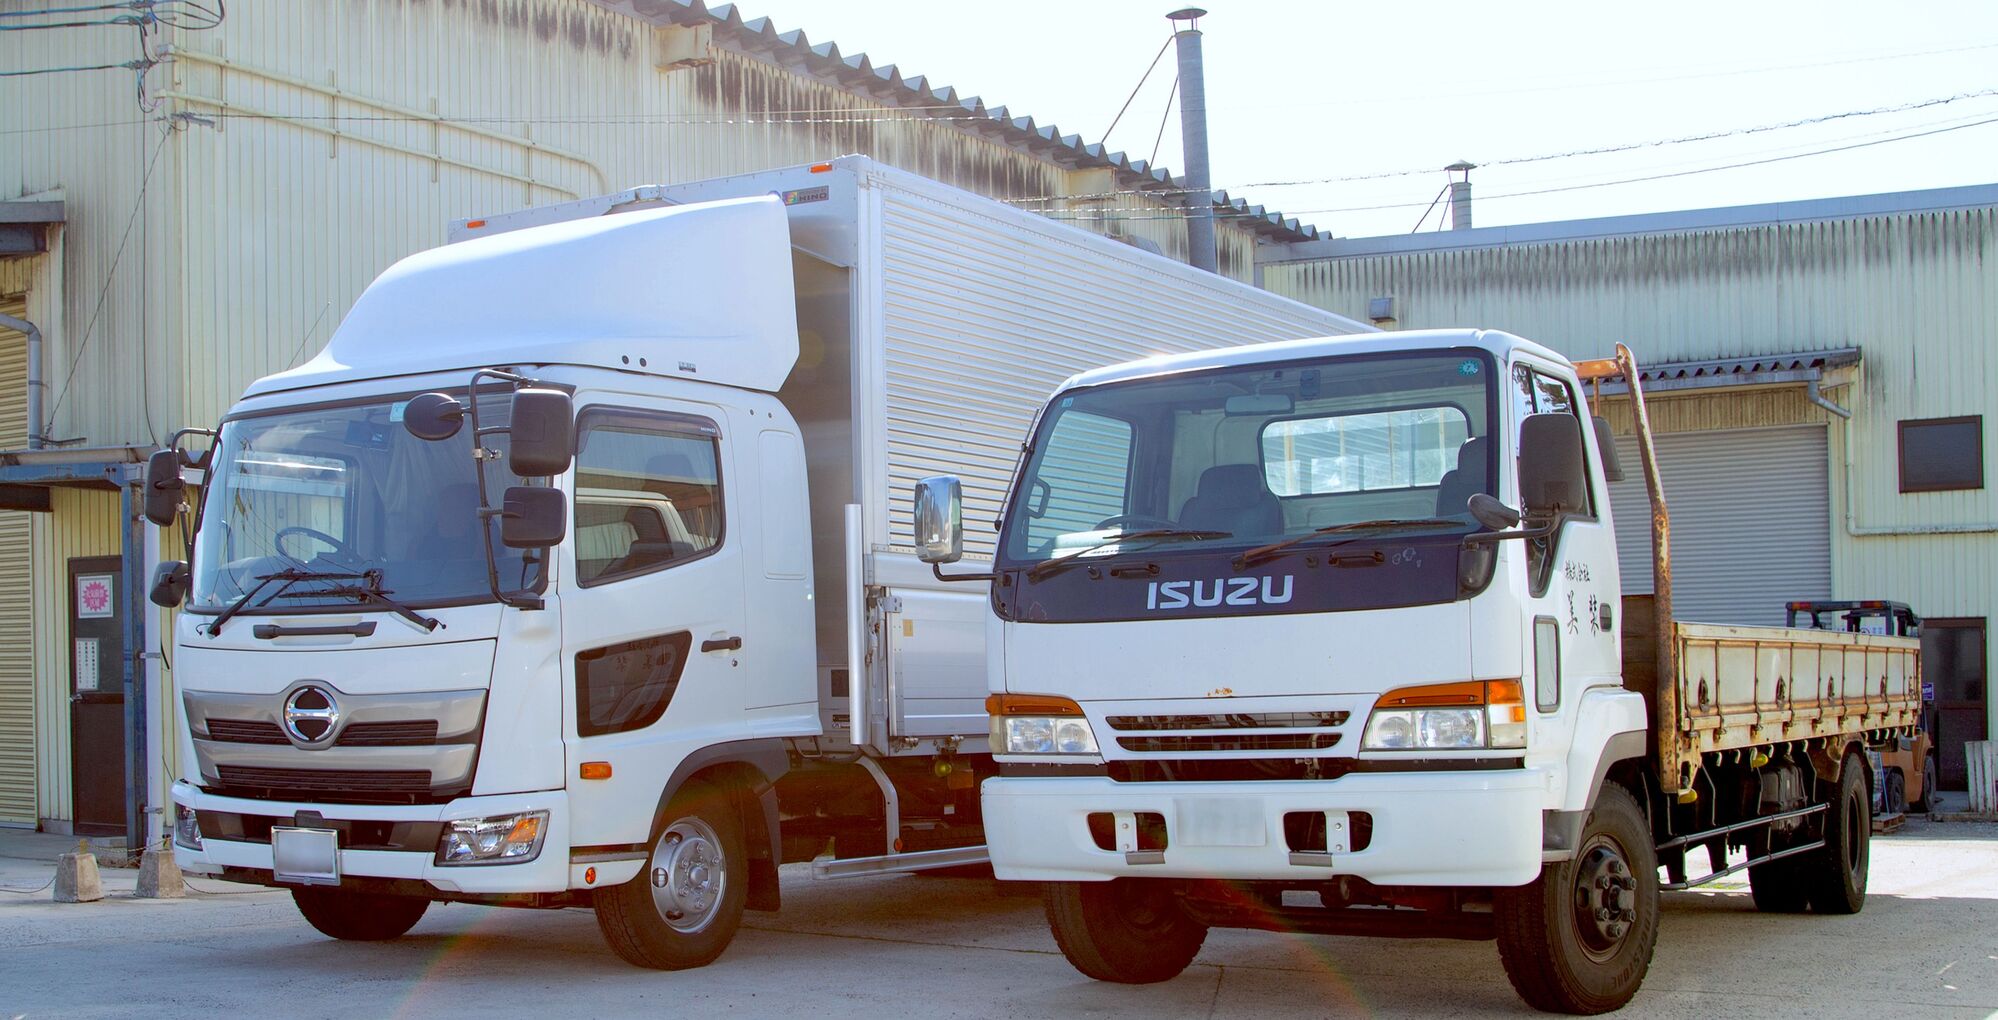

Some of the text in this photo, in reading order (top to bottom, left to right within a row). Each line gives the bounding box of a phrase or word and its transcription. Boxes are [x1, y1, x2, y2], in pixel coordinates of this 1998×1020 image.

[799, 192, 827, 202] HINO
[1565, 560, 1591, 582] 株式会社
[1147, 575, 1294, 610] ISUZU
